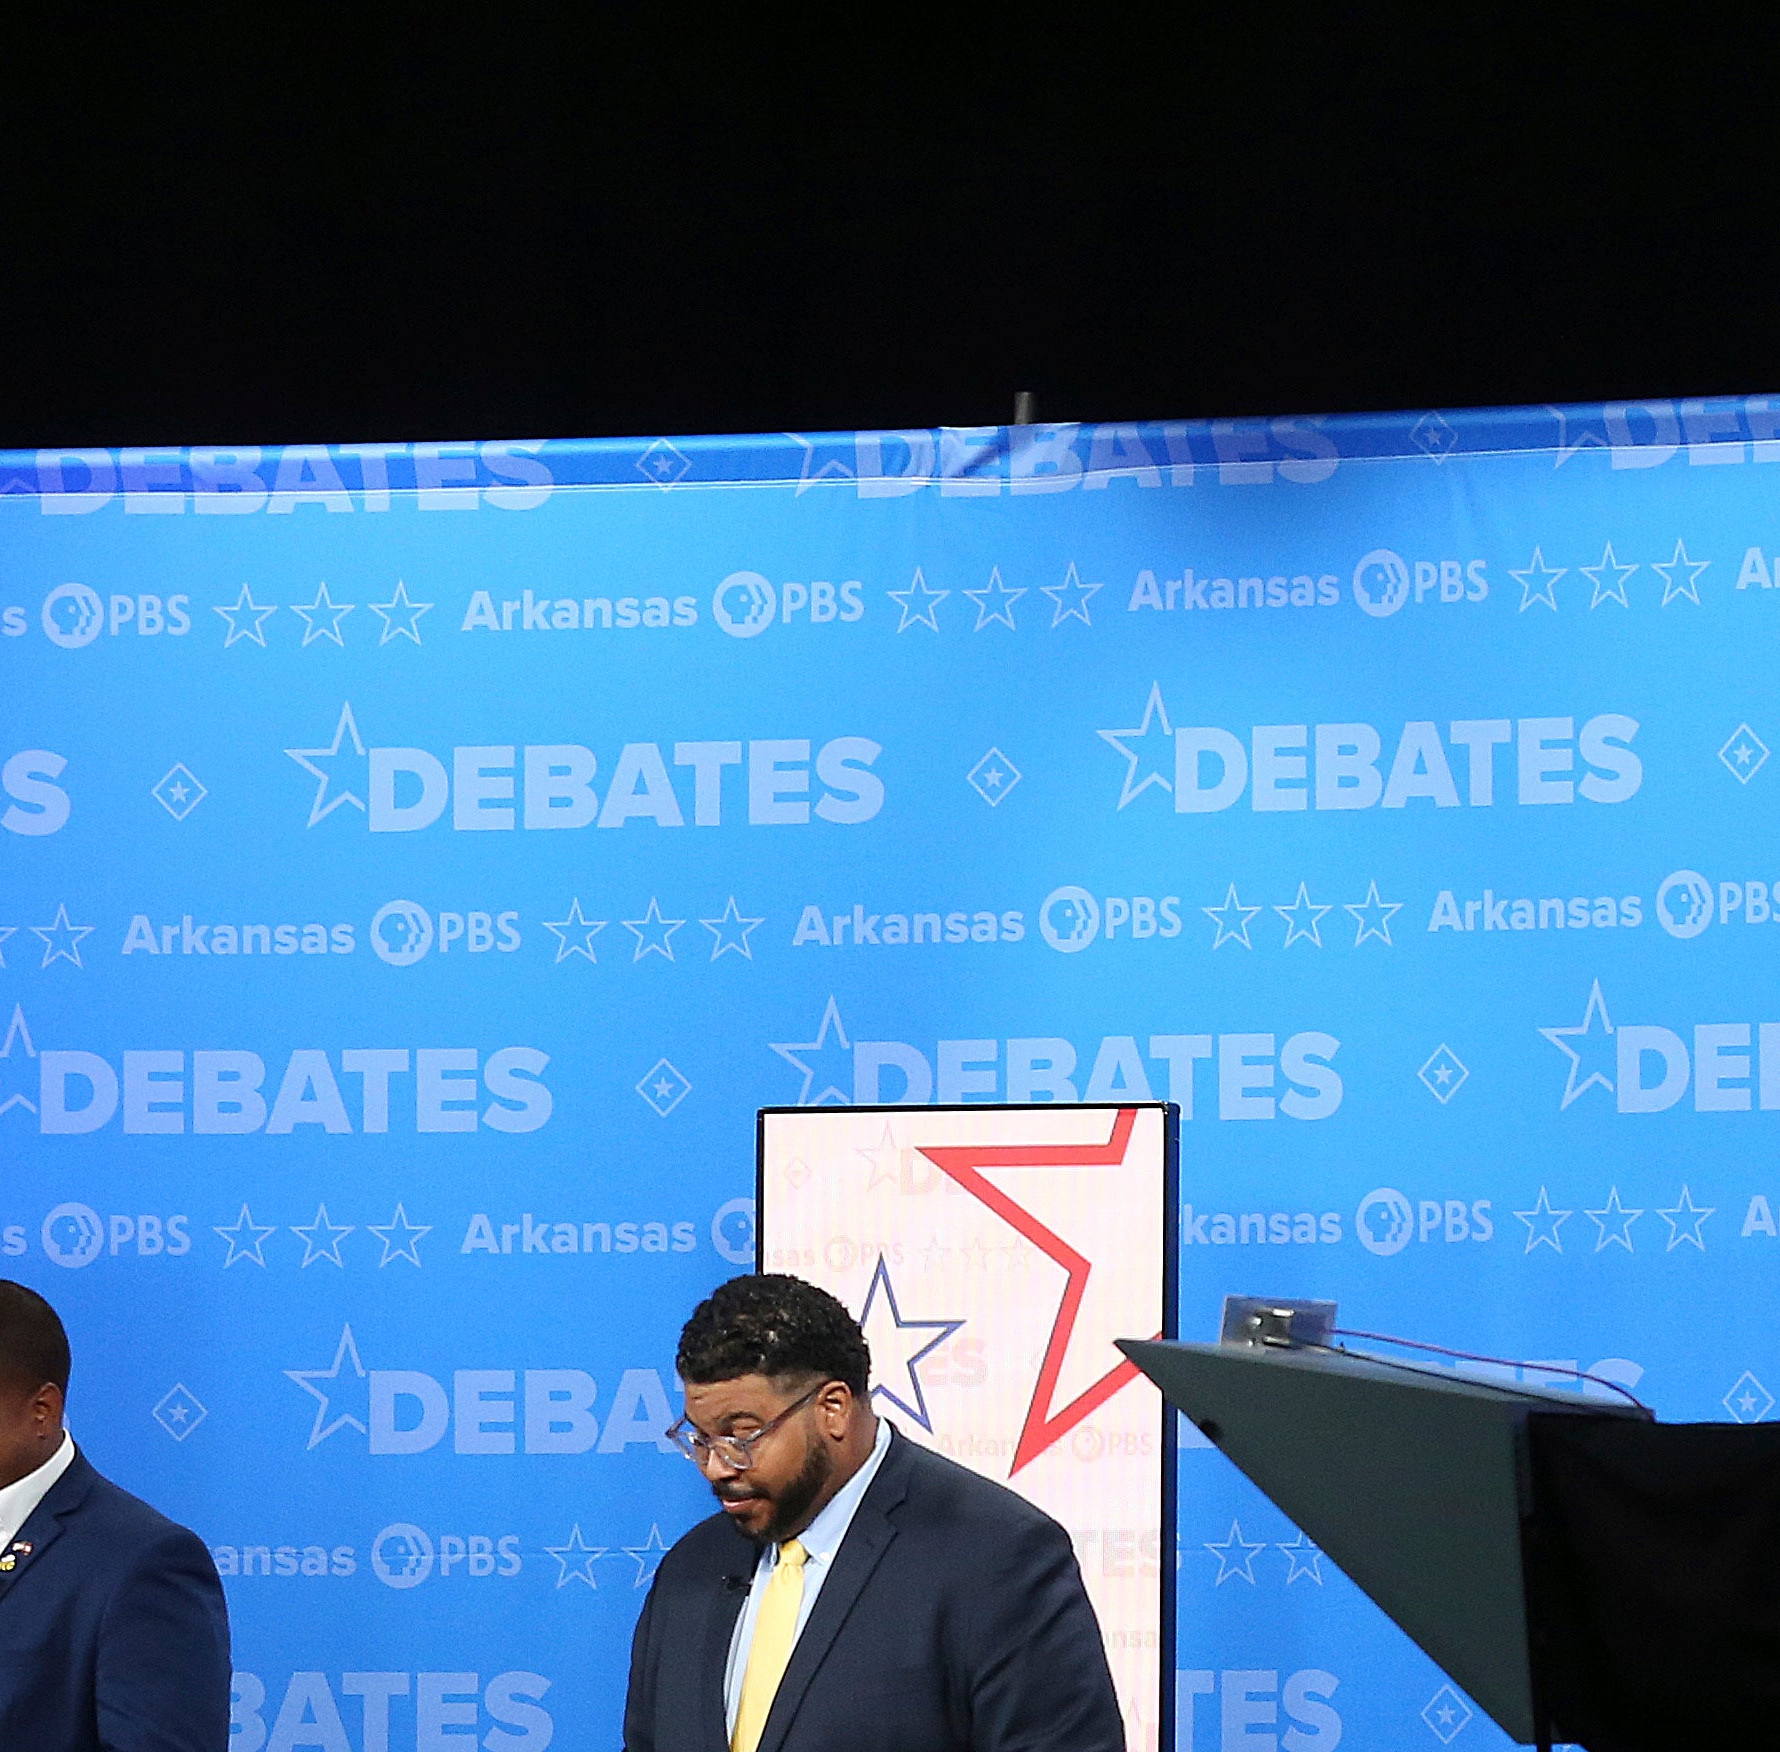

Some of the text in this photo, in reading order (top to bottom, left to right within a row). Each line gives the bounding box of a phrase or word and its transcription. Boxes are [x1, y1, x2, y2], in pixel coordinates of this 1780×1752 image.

[37, 438, 554, 516] DEBATES
[854, 416, 1340, 498] DEBATES
[461, 579, 864, 631] Arkansas PBS
[1128, 559, 1488, 612] Arkansas PBS
[111, 594, 190, 636] PBS
[370, 736, 884, 833] DEBATES
[1175, 712, 1643, 815] DEBATES
[122, 910, 521, 955] Arkansas PBS
[792, 895, 1182, 946] Arkansas PBS
[1427, 889, 1642, 933] Arkansas
[41, 1046, 553, 1135] DEBATES
[853, 1031, 1343, 1121] DEBATES
[111, 1214, 190, 1256] PBS
[461, 1214, 695, 1253] Arkansas
[1182, 1200, 1493, 1244] kansas PBS
[369, 1369, 682, 1455] DEBA
[214, 1534, 522, 1577] ansas PBS
